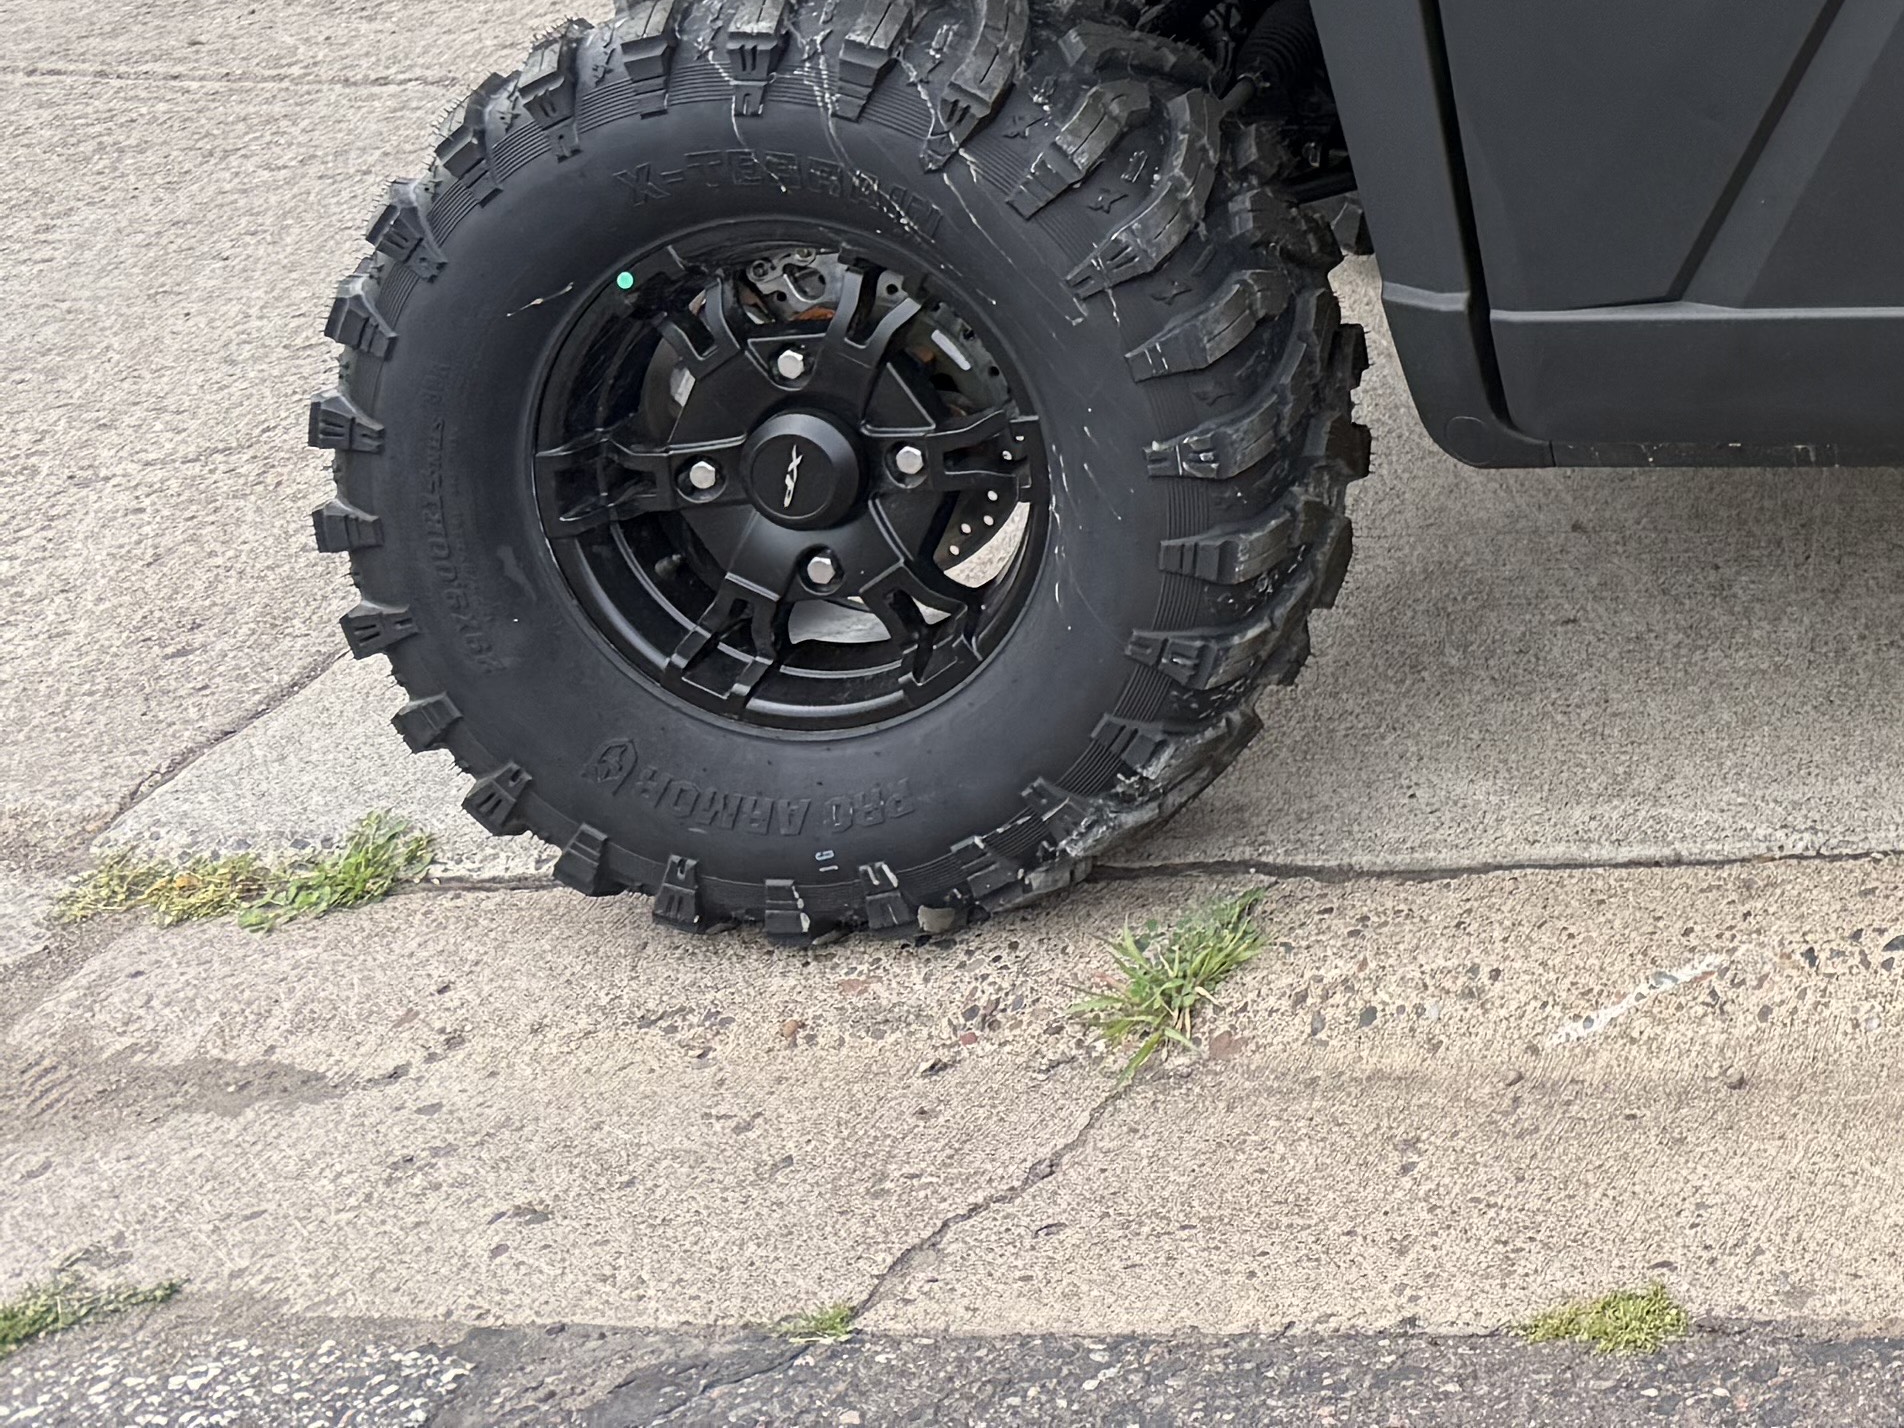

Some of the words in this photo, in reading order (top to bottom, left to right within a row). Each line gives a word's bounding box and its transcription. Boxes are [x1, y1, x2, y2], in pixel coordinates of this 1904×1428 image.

[783, 444, 804, 508] XP
[633, 765, 812, 837] ARMOR
[822, 777, 917, 835] PRO
